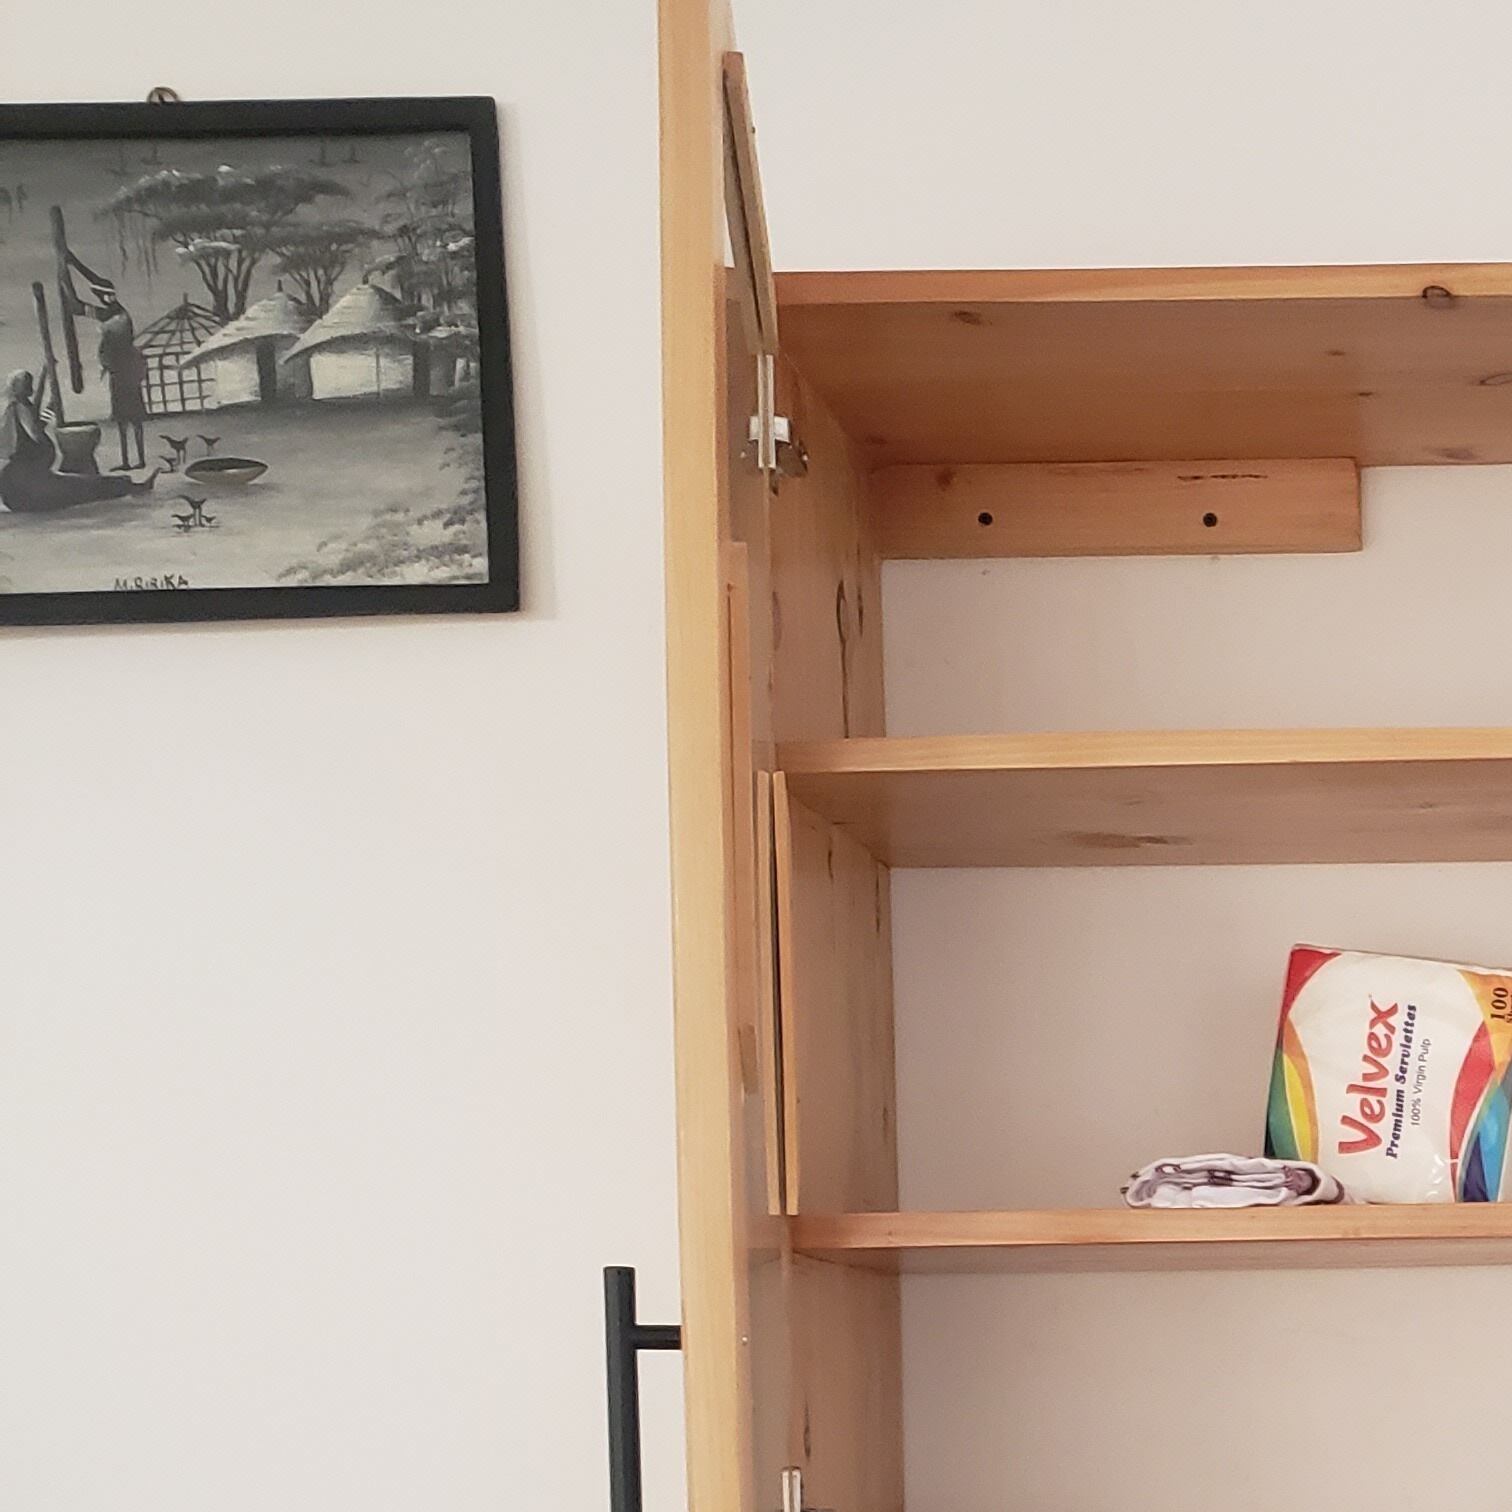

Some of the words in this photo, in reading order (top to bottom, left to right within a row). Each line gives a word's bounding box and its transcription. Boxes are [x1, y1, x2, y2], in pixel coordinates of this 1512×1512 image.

[1490, 987, 1509, 1020] 100
[1394, 1004, 1417, 1084] Serviettes
[1419, 1038, 1432, 1064] Pulp
[1338, 1000, 1398, 1155] Velvex
[1413, 1056, 1426, 1094] Virgin
[1386, 1089, 1405, 1159] Premium
[1410, 1096, 1423, 1126] 100%
